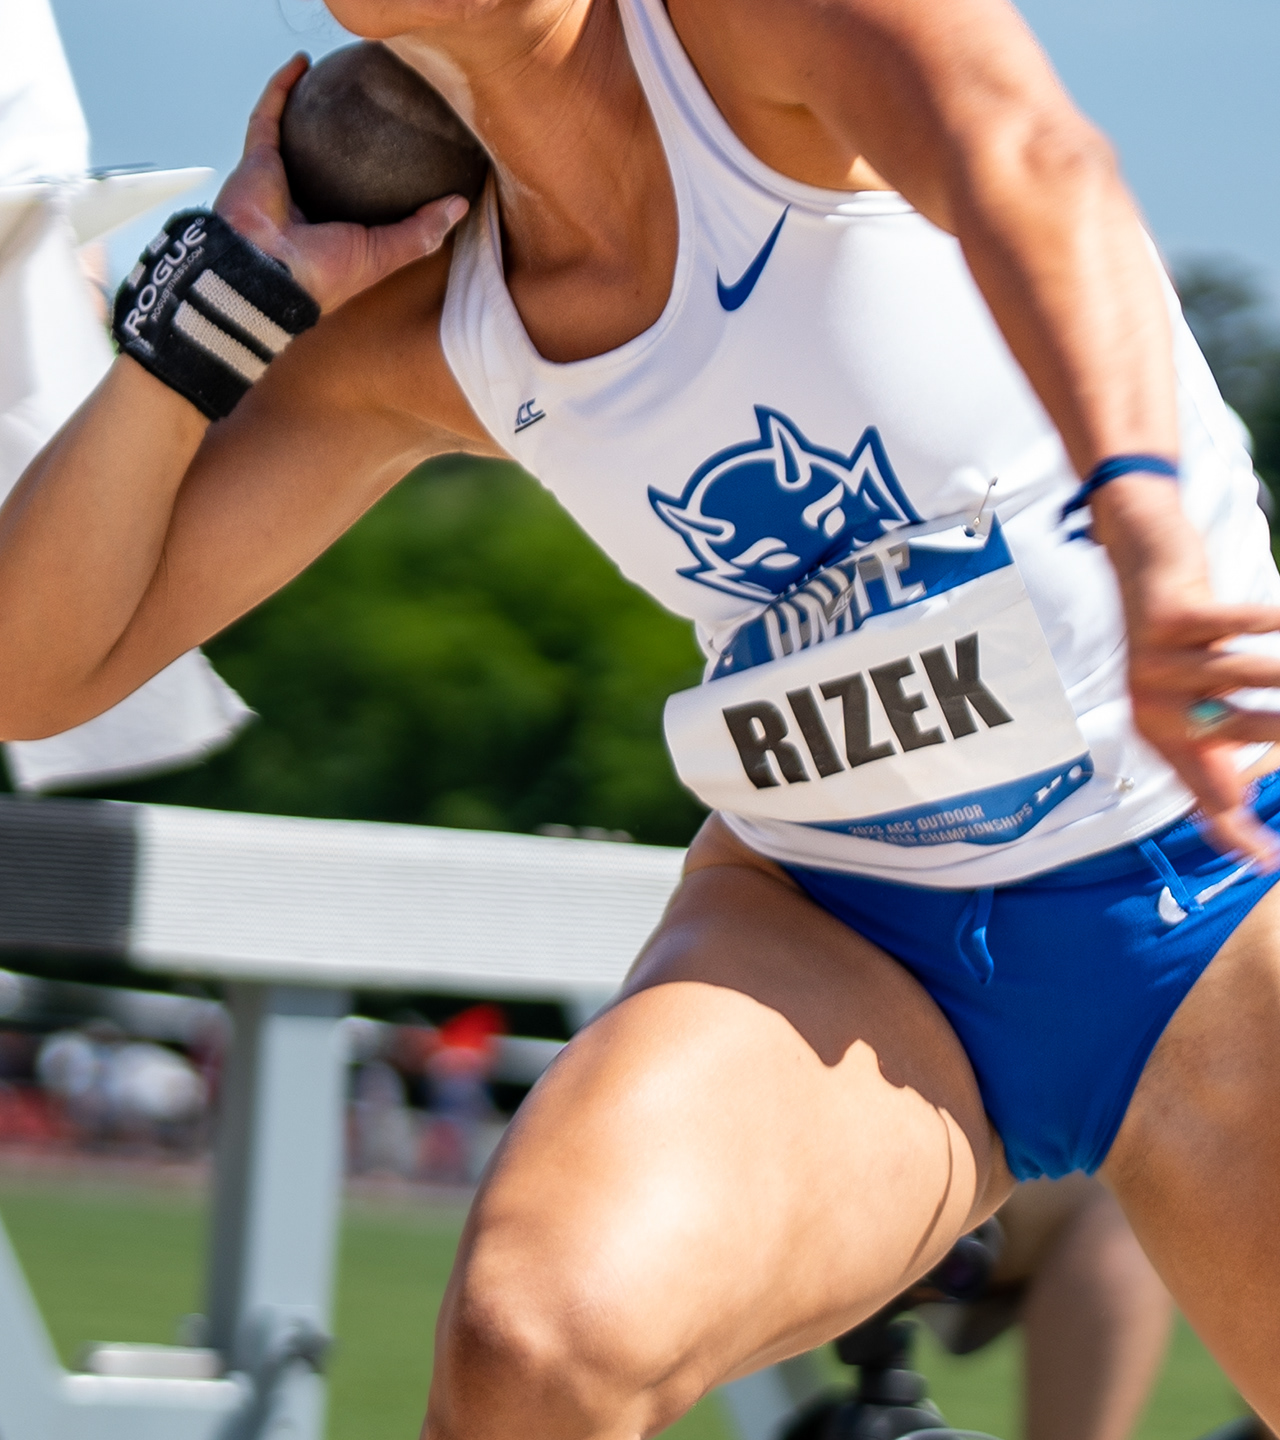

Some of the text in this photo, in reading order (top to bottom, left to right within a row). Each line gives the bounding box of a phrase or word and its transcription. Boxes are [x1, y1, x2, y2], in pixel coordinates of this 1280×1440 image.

[722, 631, 1014, 789] RIZEK
[886, 820, 915, 834] ACC
[917, 804, 985, 831] OUTDOOR
[918, 802, 1033, 843] CHAMPIONSHIPS
